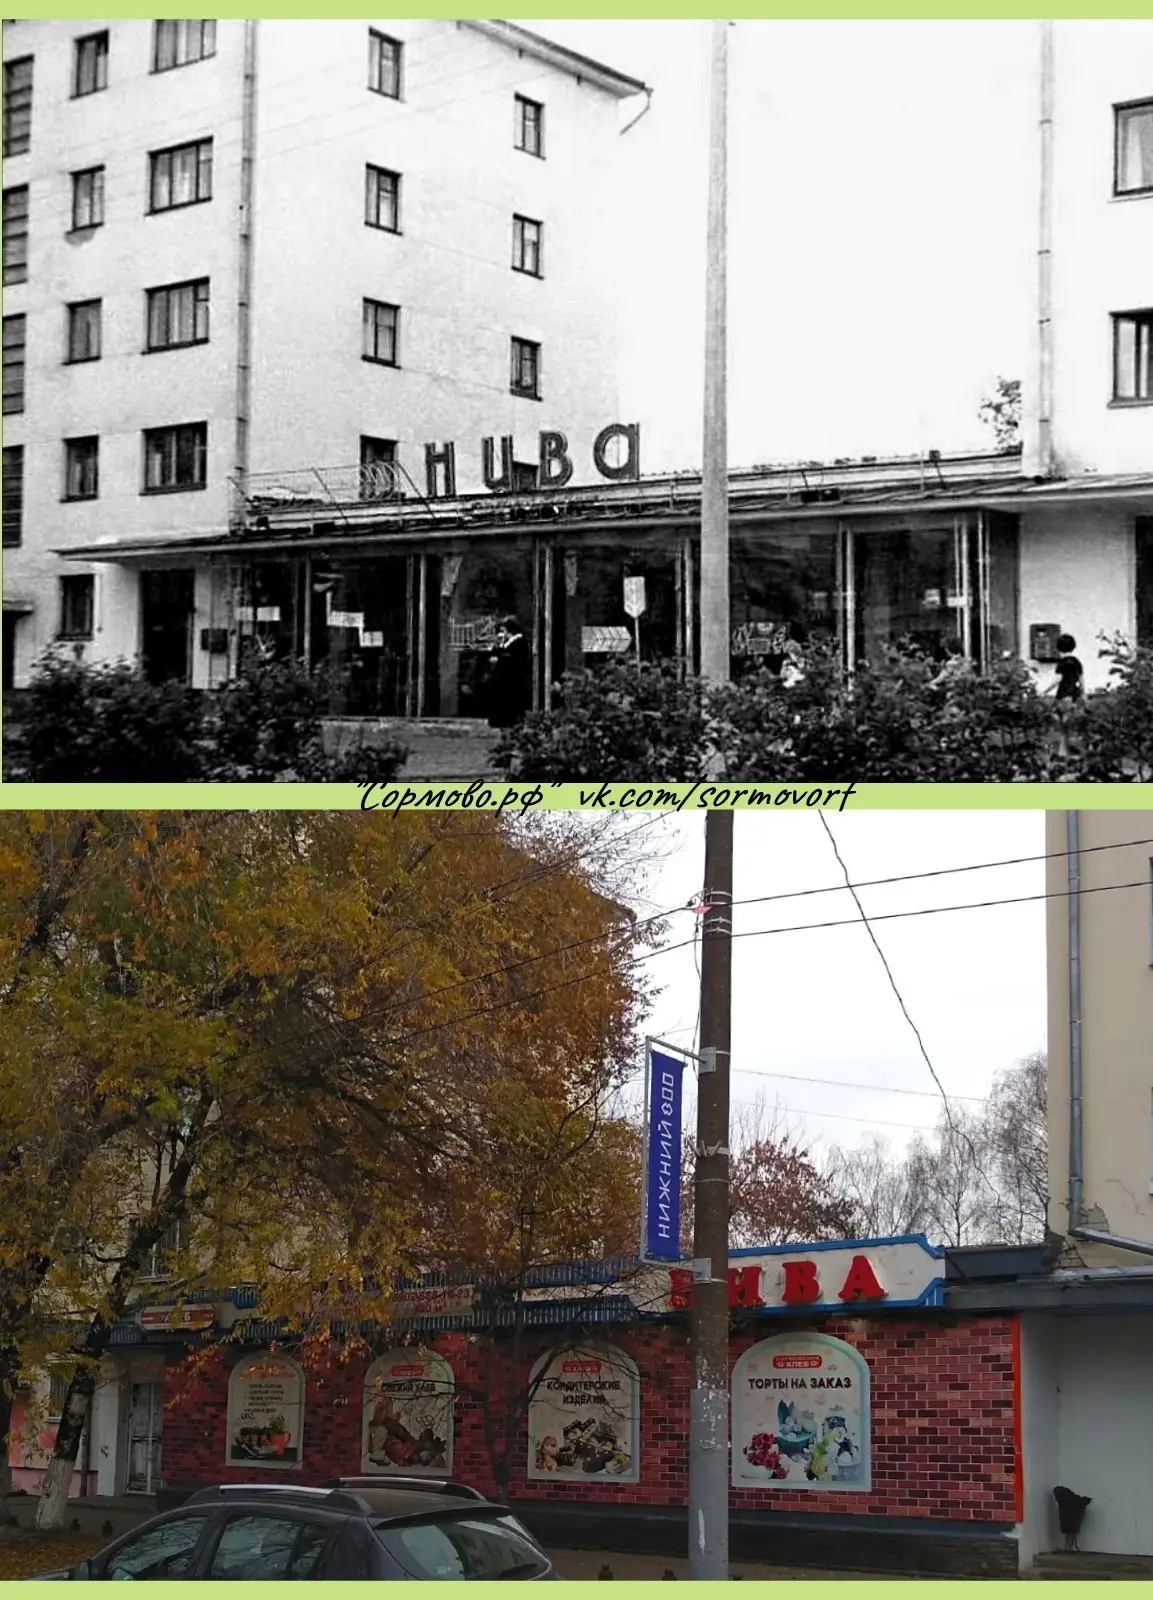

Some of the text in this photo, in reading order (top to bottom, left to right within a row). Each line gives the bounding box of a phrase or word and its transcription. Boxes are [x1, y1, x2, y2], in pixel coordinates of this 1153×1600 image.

[748, 1377, 852, 1390] ТОРТЫ НА ЗАКАЗ
